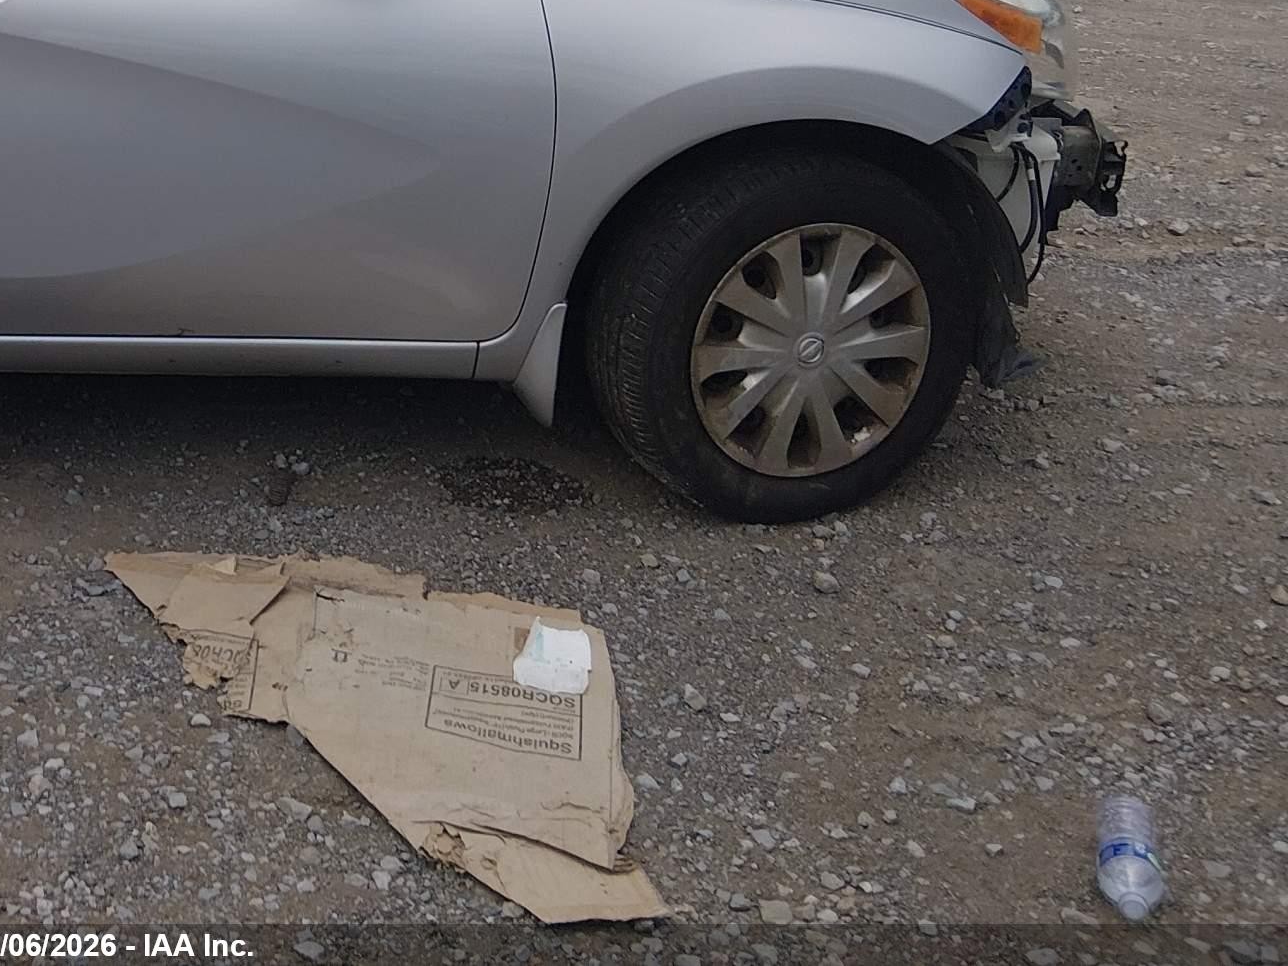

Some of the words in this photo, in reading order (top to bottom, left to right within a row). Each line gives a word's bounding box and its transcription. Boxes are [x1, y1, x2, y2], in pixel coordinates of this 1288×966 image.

[448, 679, 460, 691] A
[469, 681, 576, 708] SQCR08515
[443, 718, 572, 755] Squishmallows
